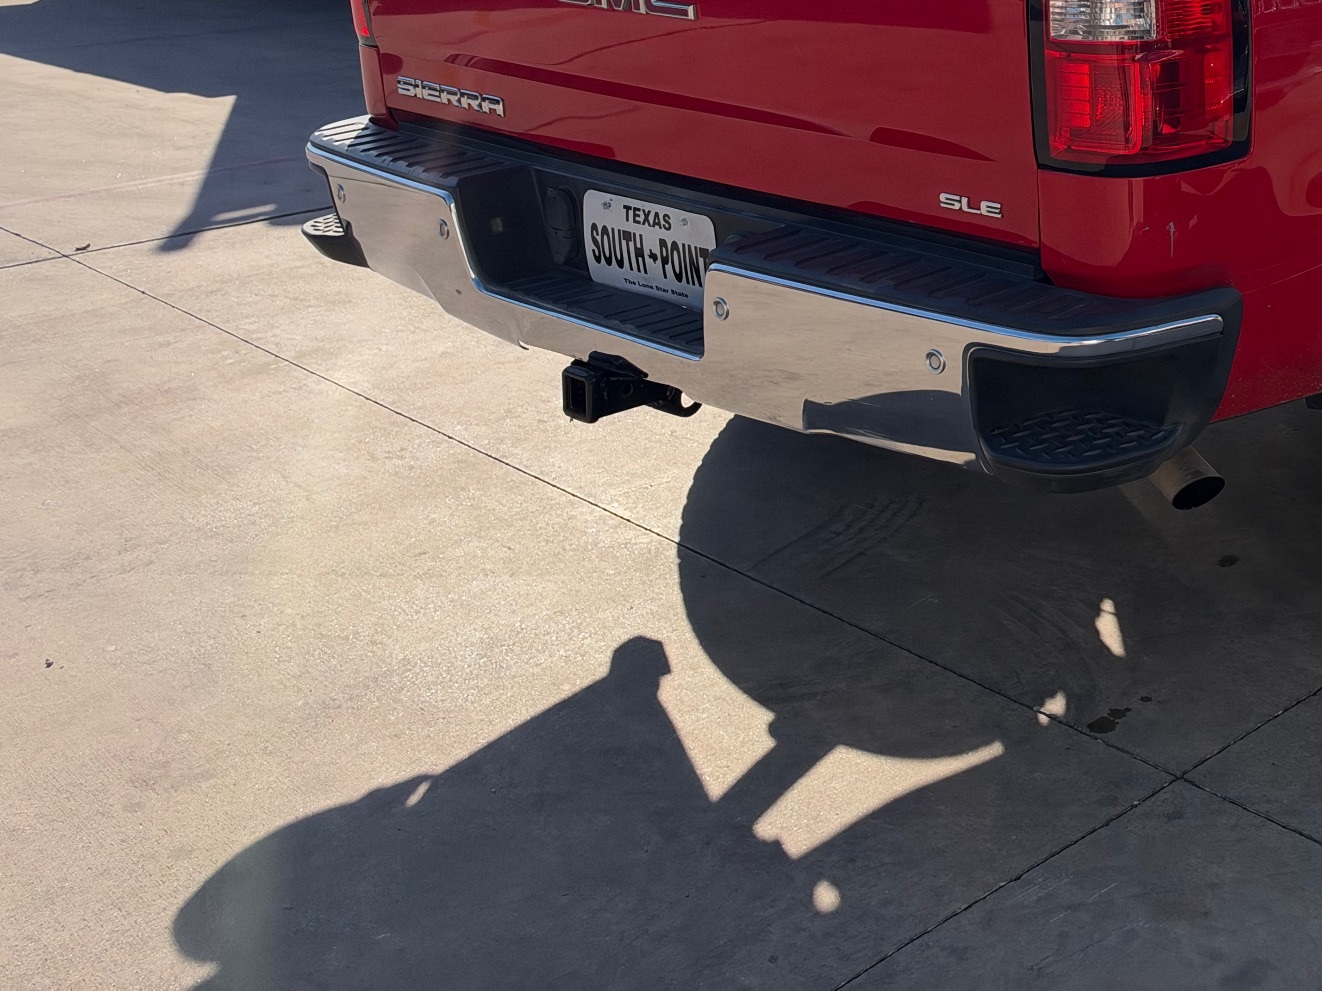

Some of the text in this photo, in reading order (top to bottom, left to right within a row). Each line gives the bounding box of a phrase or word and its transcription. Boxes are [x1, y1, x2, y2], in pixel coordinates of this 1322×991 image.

[397, 75, 504, 118] SIERRA
[622, 204, 671, 231] TEXAS
[939, 192, 1002, 219] SLE
[590, 222, 710, 288] SOUTH POINT
[623, 278, 689, 298] The Lone Star State
